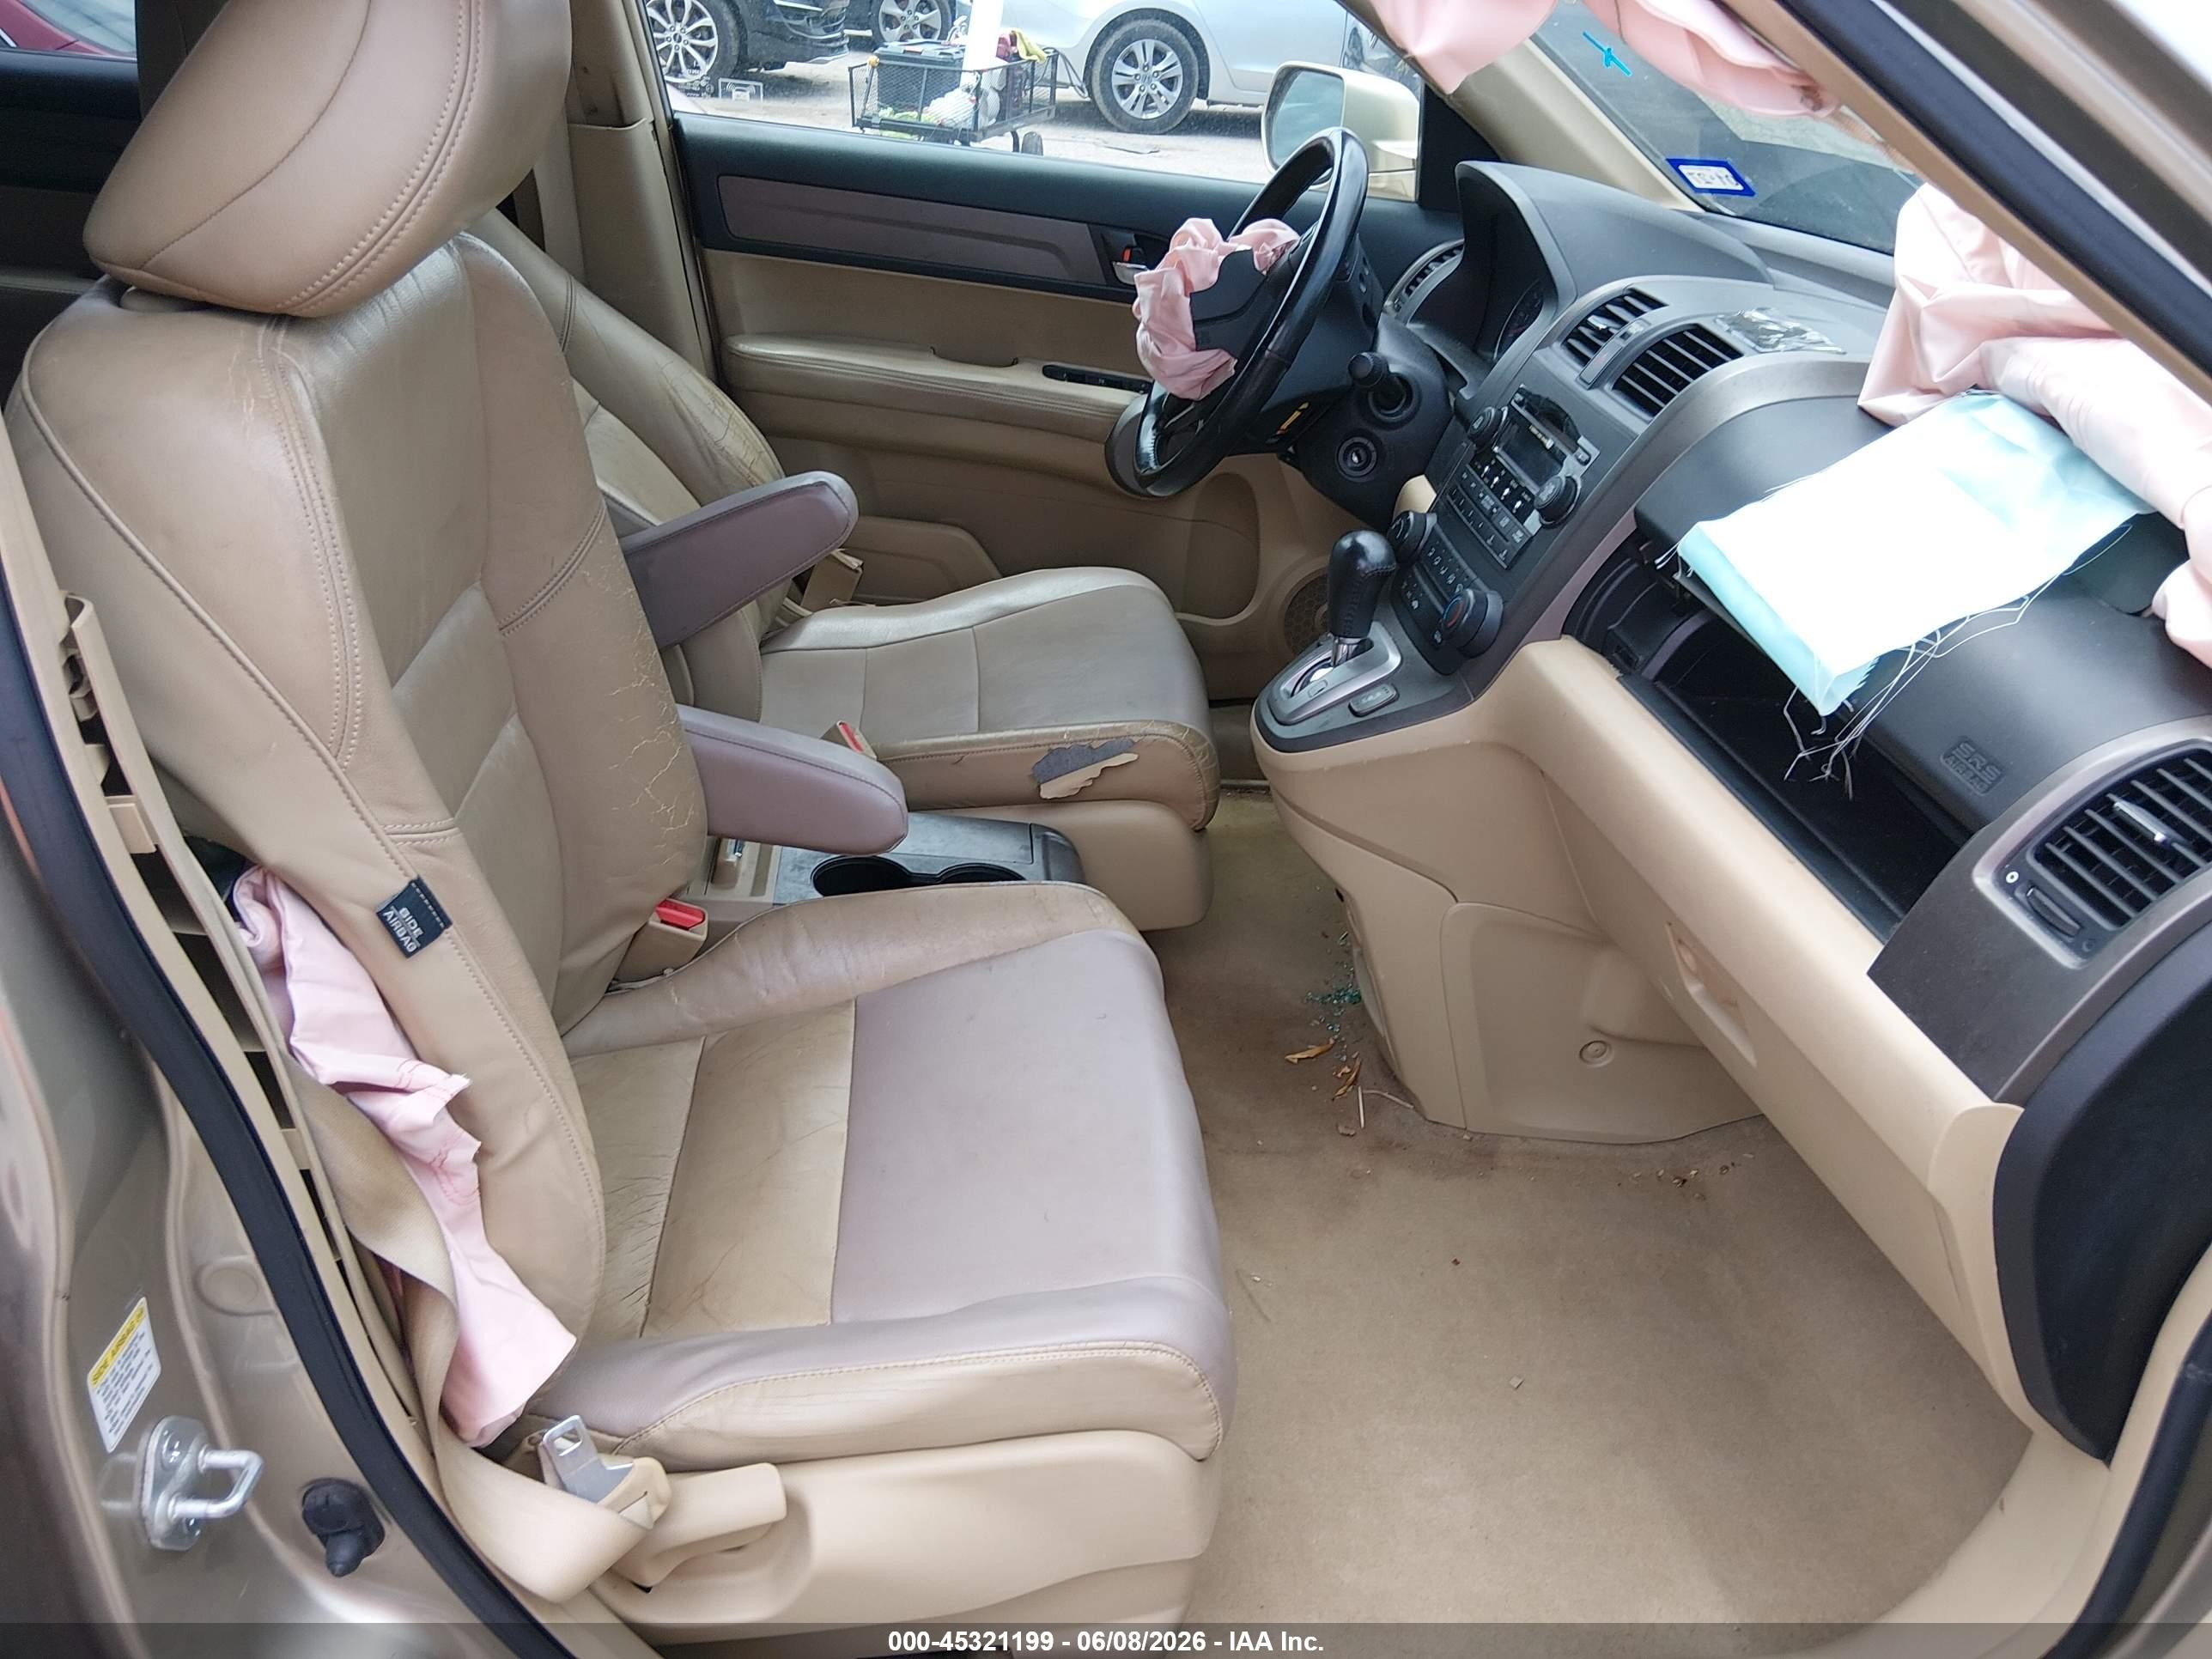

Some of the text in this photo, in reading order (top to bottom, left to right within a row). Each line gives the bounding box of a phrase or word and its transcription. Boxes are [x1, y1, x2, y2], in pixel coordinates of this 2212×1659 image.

[1956, 741, 2002, 781] SRS
[382, 910, 417, 953] AIRBAG
[398, 907, 424, 939] SIDE
